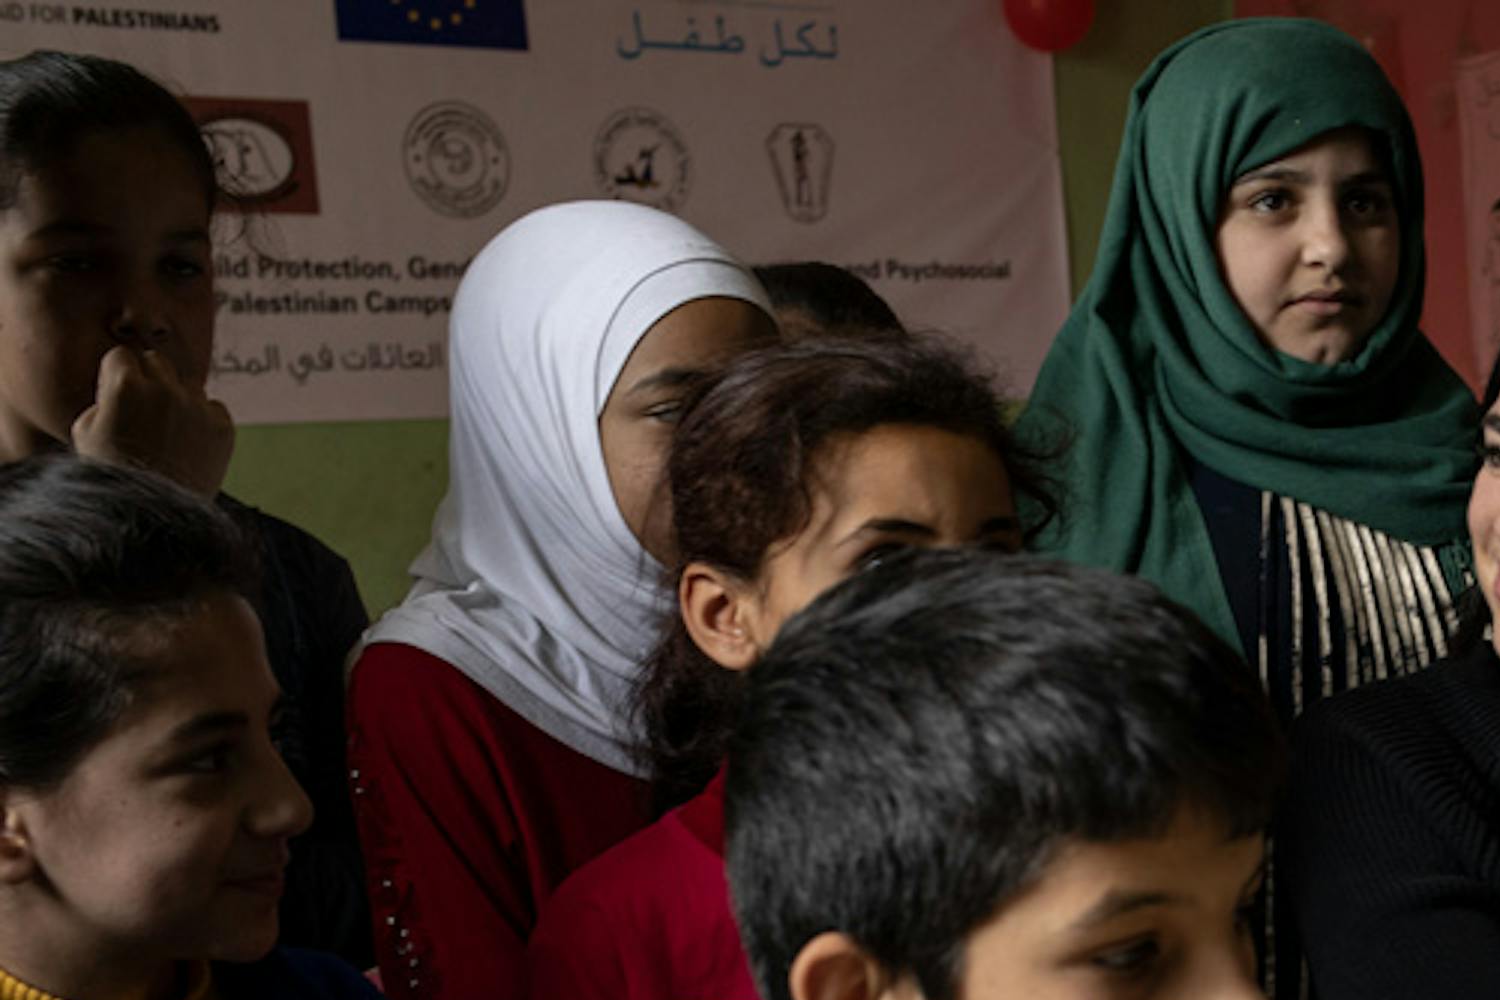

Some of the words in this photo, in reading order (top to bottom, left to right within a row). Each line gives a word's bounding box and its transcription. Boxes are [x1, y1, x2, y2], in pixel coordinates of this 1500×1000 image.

[30, 4, 66, 25] FOR
[71, 5, 221, 34] PALESTINIANS
[615, 9, 746, 61] طفل
[759, 18, 839, 68] لكل
[214, 253, 249, 279] ild
[256, 253, 403, 283] Protection,
[886, 257, 1012, 284] Psychosocial
[213, 290, 358, 316] Palestinian
[288, 343, 334, 386] في
